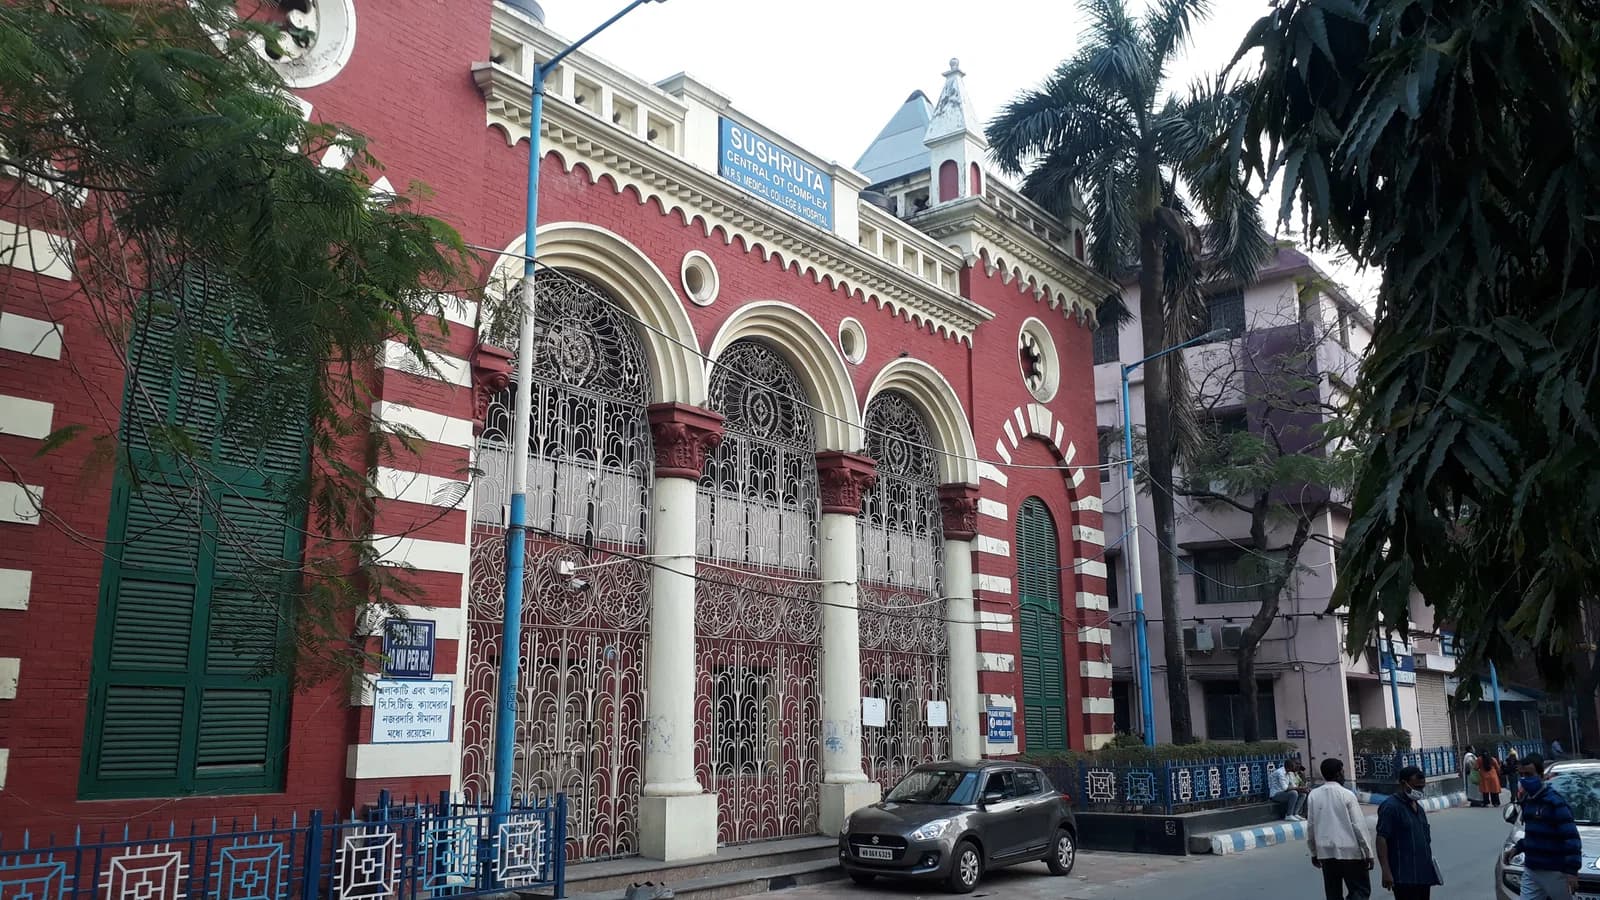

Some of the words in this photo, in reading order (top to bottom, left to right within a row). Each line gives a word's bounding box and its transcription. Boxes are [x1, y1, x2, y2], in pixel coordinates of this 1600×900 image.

[731, 127, 825, 195] SUSHRUTA
[727, 150, 770, 181] CENTRAL
[773, 174, 785, 188] OT
[787, 181, 828, 210] COMPLEX
[744, 177, 769, 198] MEDICAL
[770, 190, 797, 210] COLLEGE
[802, 206, 828, 226] HOSPITAL
[412, 625, 429, 646] LIMIT
[396, 648, 406, 670] KM
[407, 650, 419, 671] PER
[429, 684, 449, 695] আপনি
